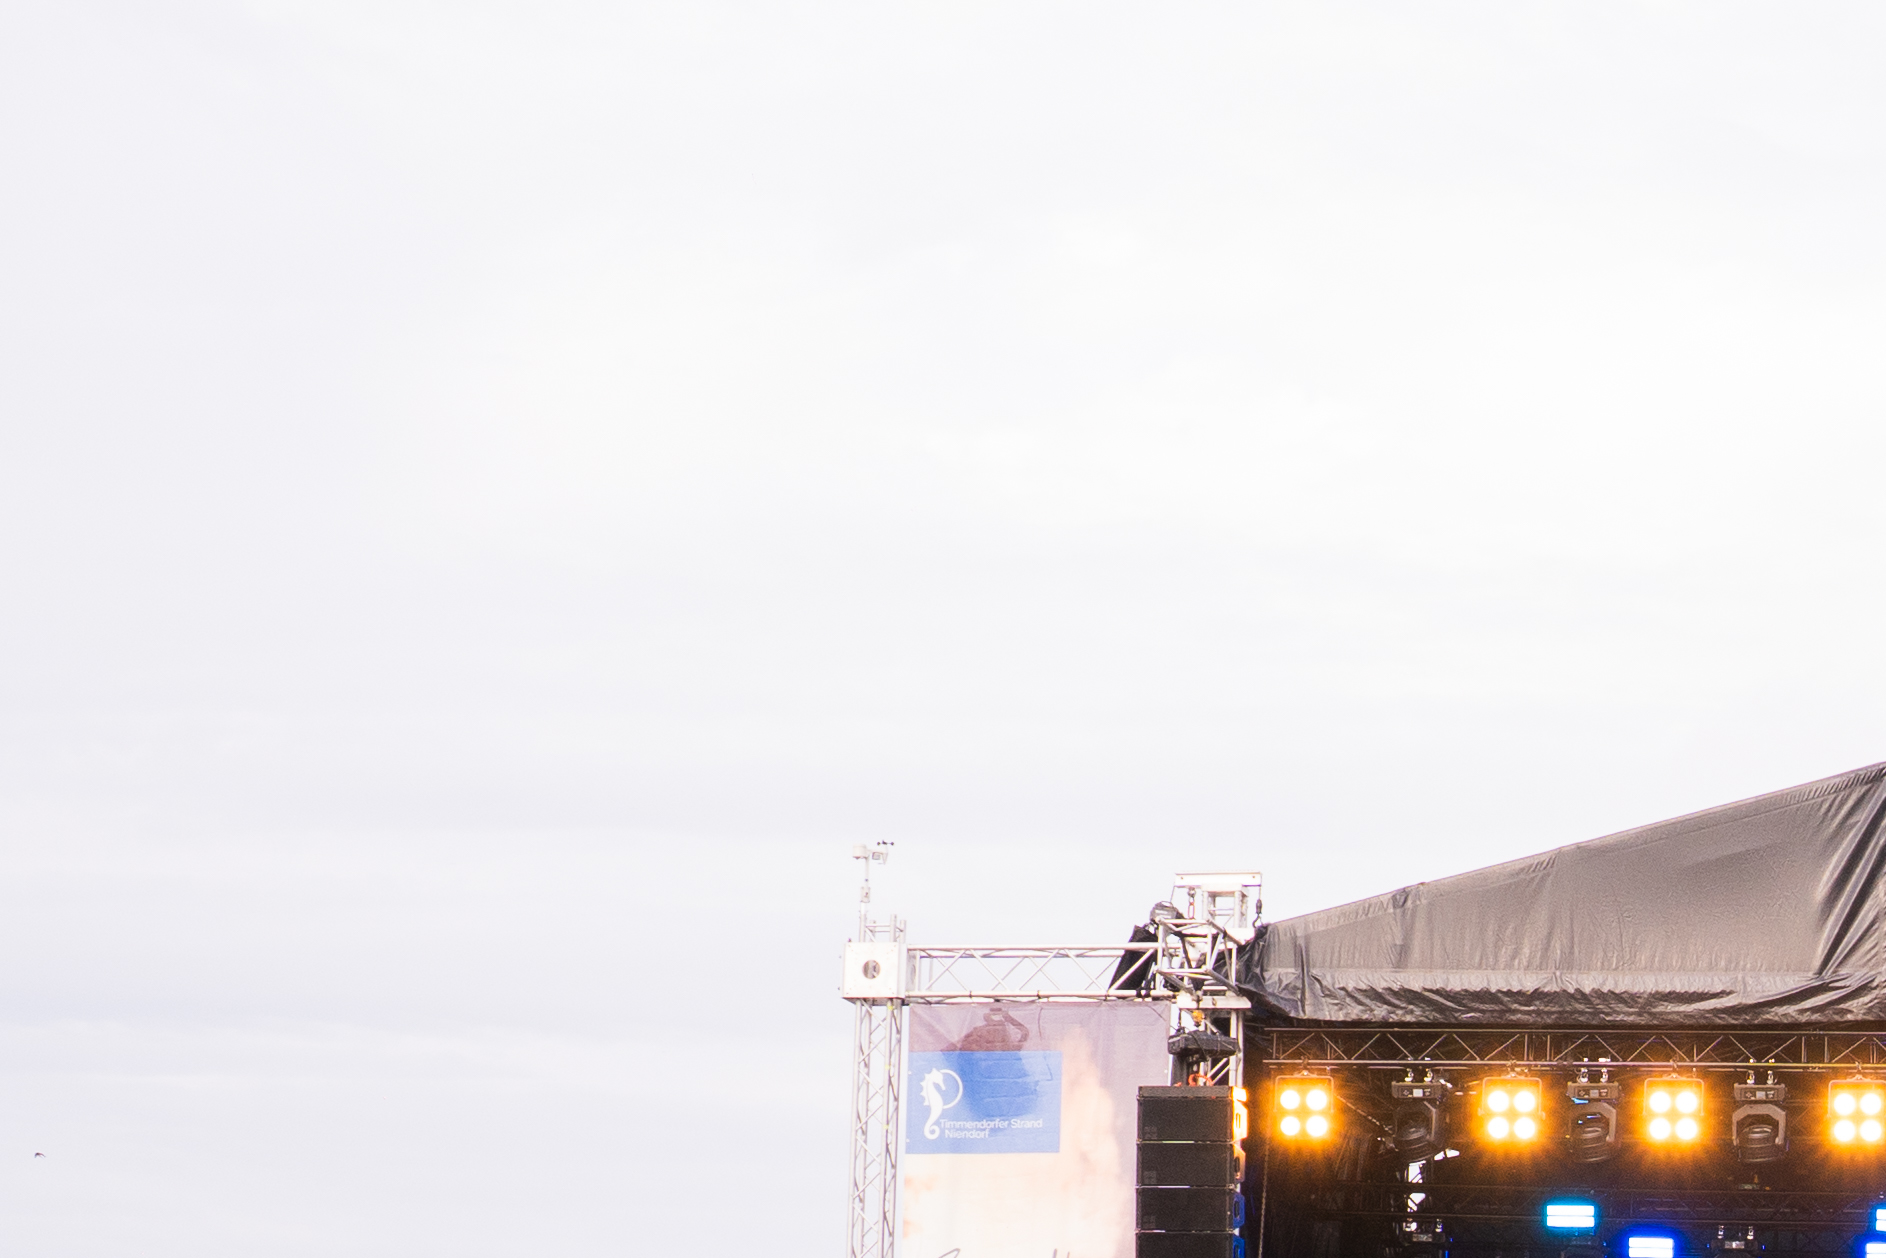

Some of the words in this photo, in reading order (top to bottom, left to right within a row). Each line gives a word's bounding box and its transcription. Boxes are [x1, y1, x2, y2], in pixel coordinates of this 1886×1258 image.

[939, 1118, 1010, 1129] Timmendorfer
[1010, 1118, 1043, 1129] Strand
[944, 1129, 990, 1139] Niendorf
